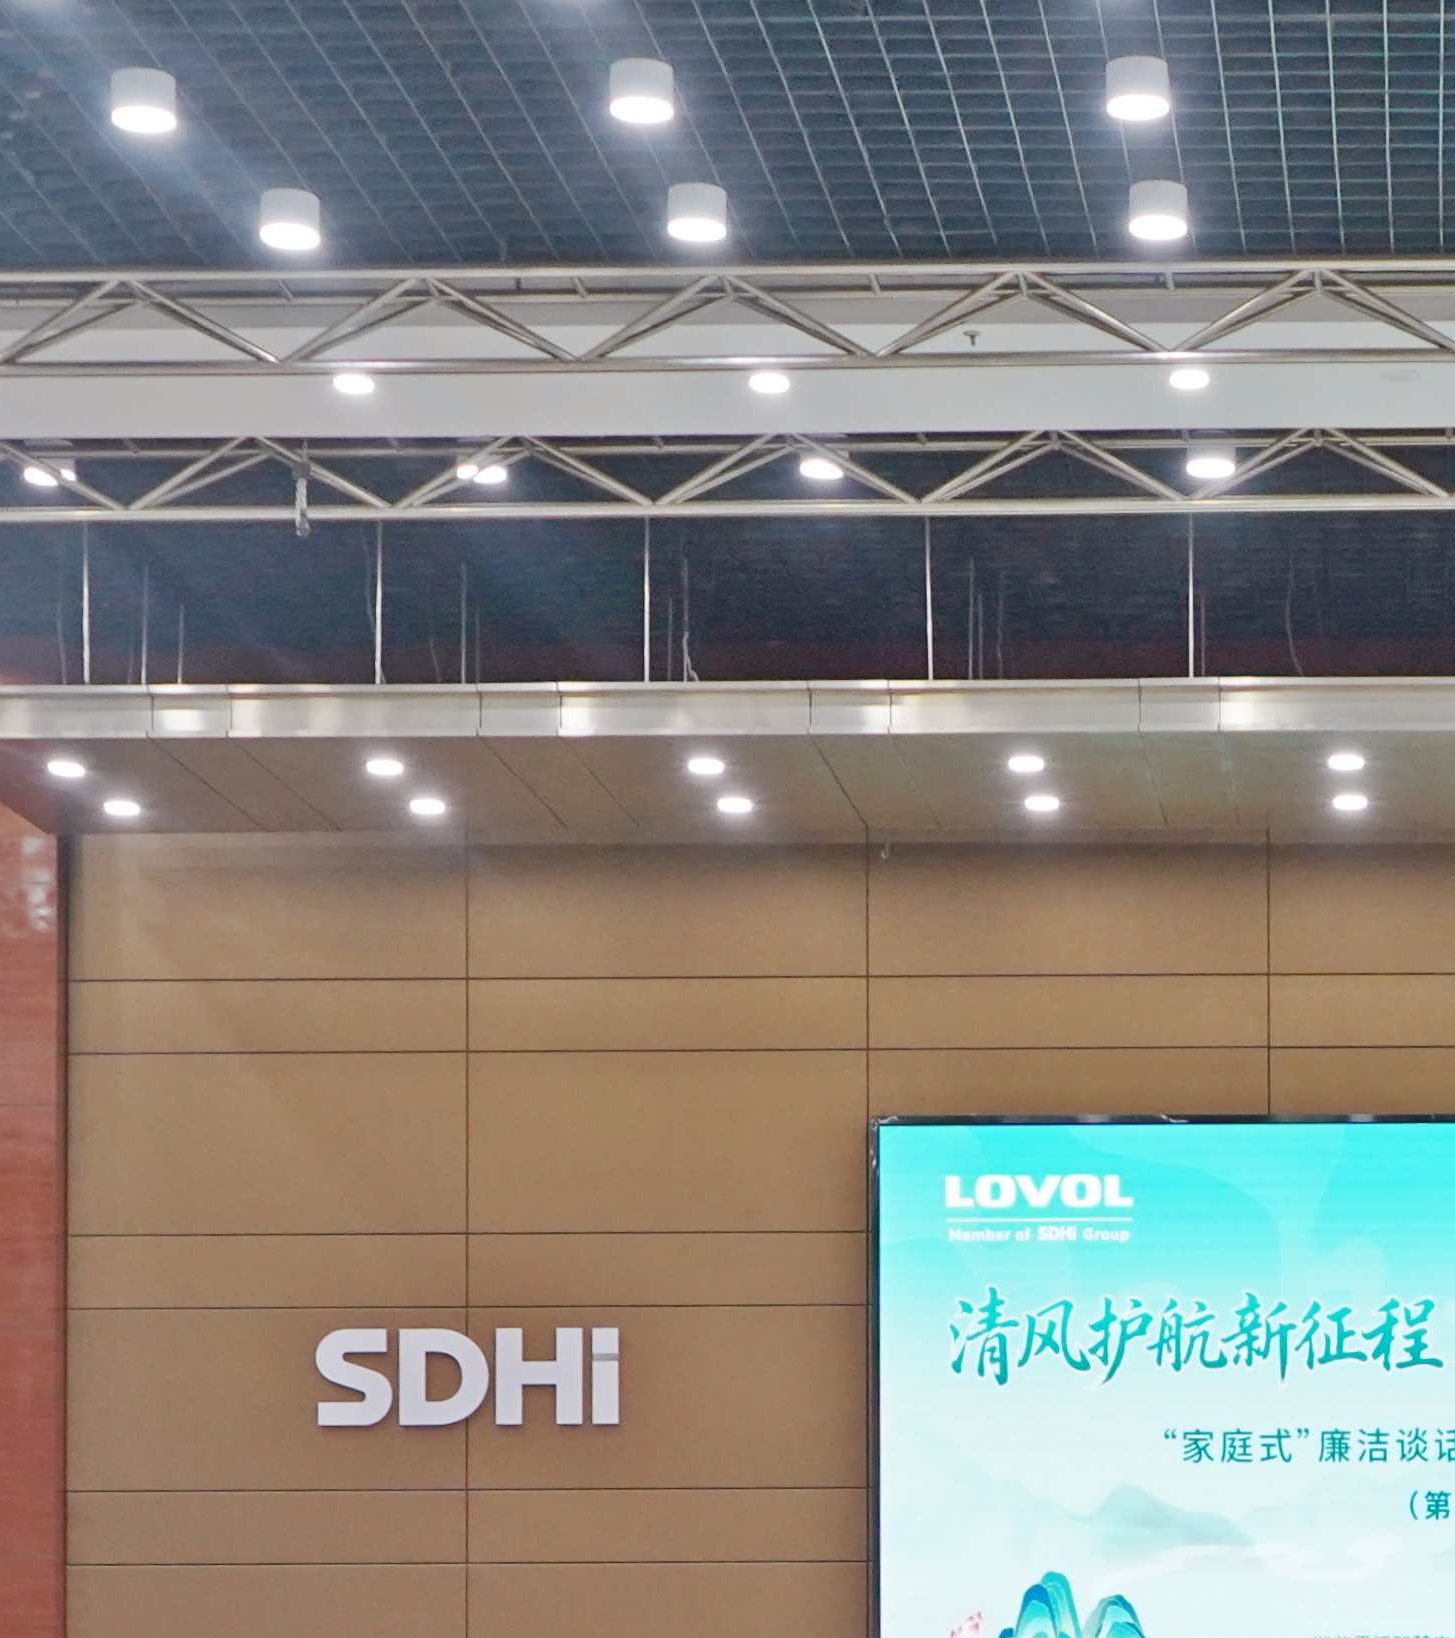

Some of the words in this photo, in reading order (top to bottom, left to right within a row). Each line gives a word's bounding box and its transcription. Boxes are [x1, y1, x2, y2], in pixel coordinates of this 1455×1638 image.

[945, 1173, 1135, 1209] LOVOL
[948, 1227, 1012, 1242] Member
[1014, 1226, 1033, 1242] of
[1037, 1225, 1077, 1242] SDHi
[1082, 1227, 1131, 1244] Group
[949, 1286, 1445, 1388] 清风护航新征程
[314, 1327, 620, 1427] SDHi
